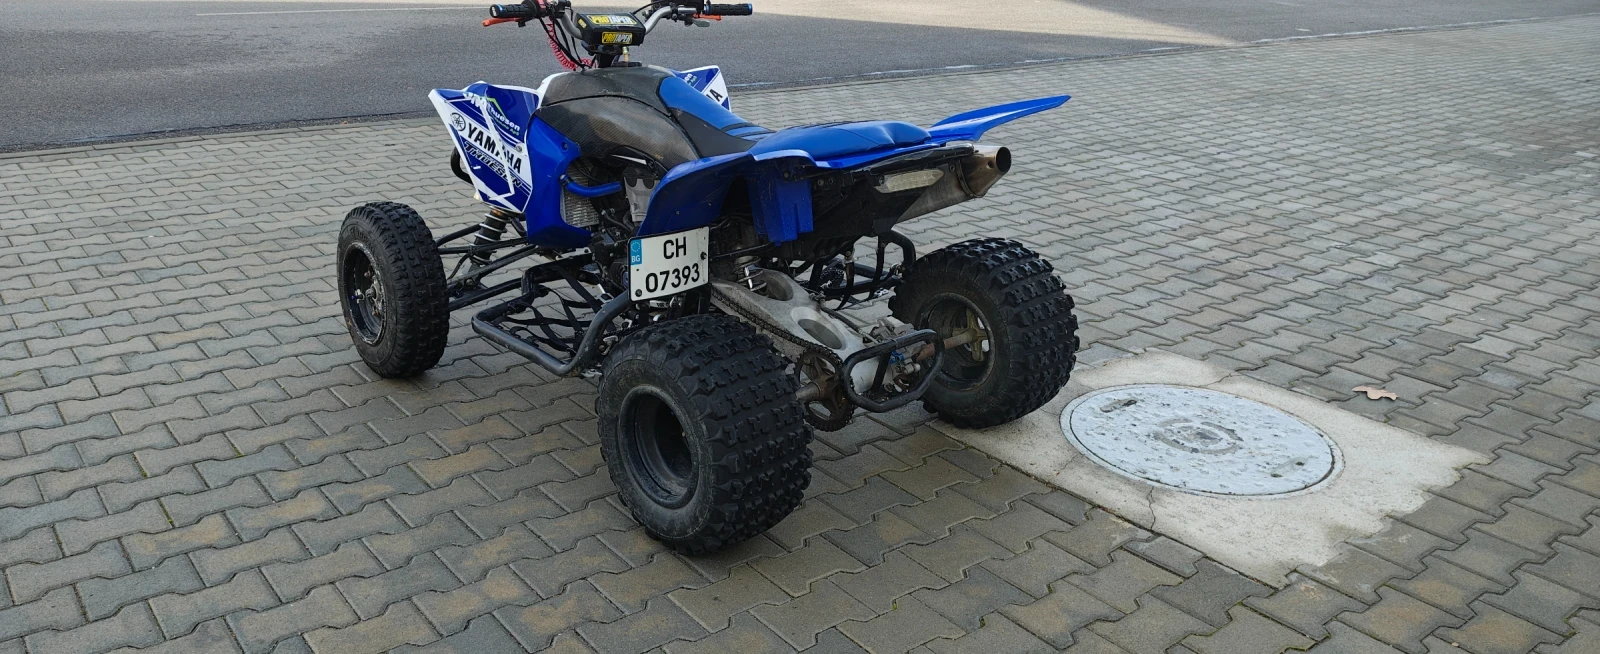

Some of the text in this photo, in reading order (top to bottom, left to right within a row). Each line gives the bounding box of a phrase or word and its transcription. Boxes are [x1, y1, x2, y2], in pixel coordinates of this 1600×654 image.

[603, 33, 632, 43] PROTAPER
[663, 236, 687, 259] CH
[645, 263, 700, 293] 07393
